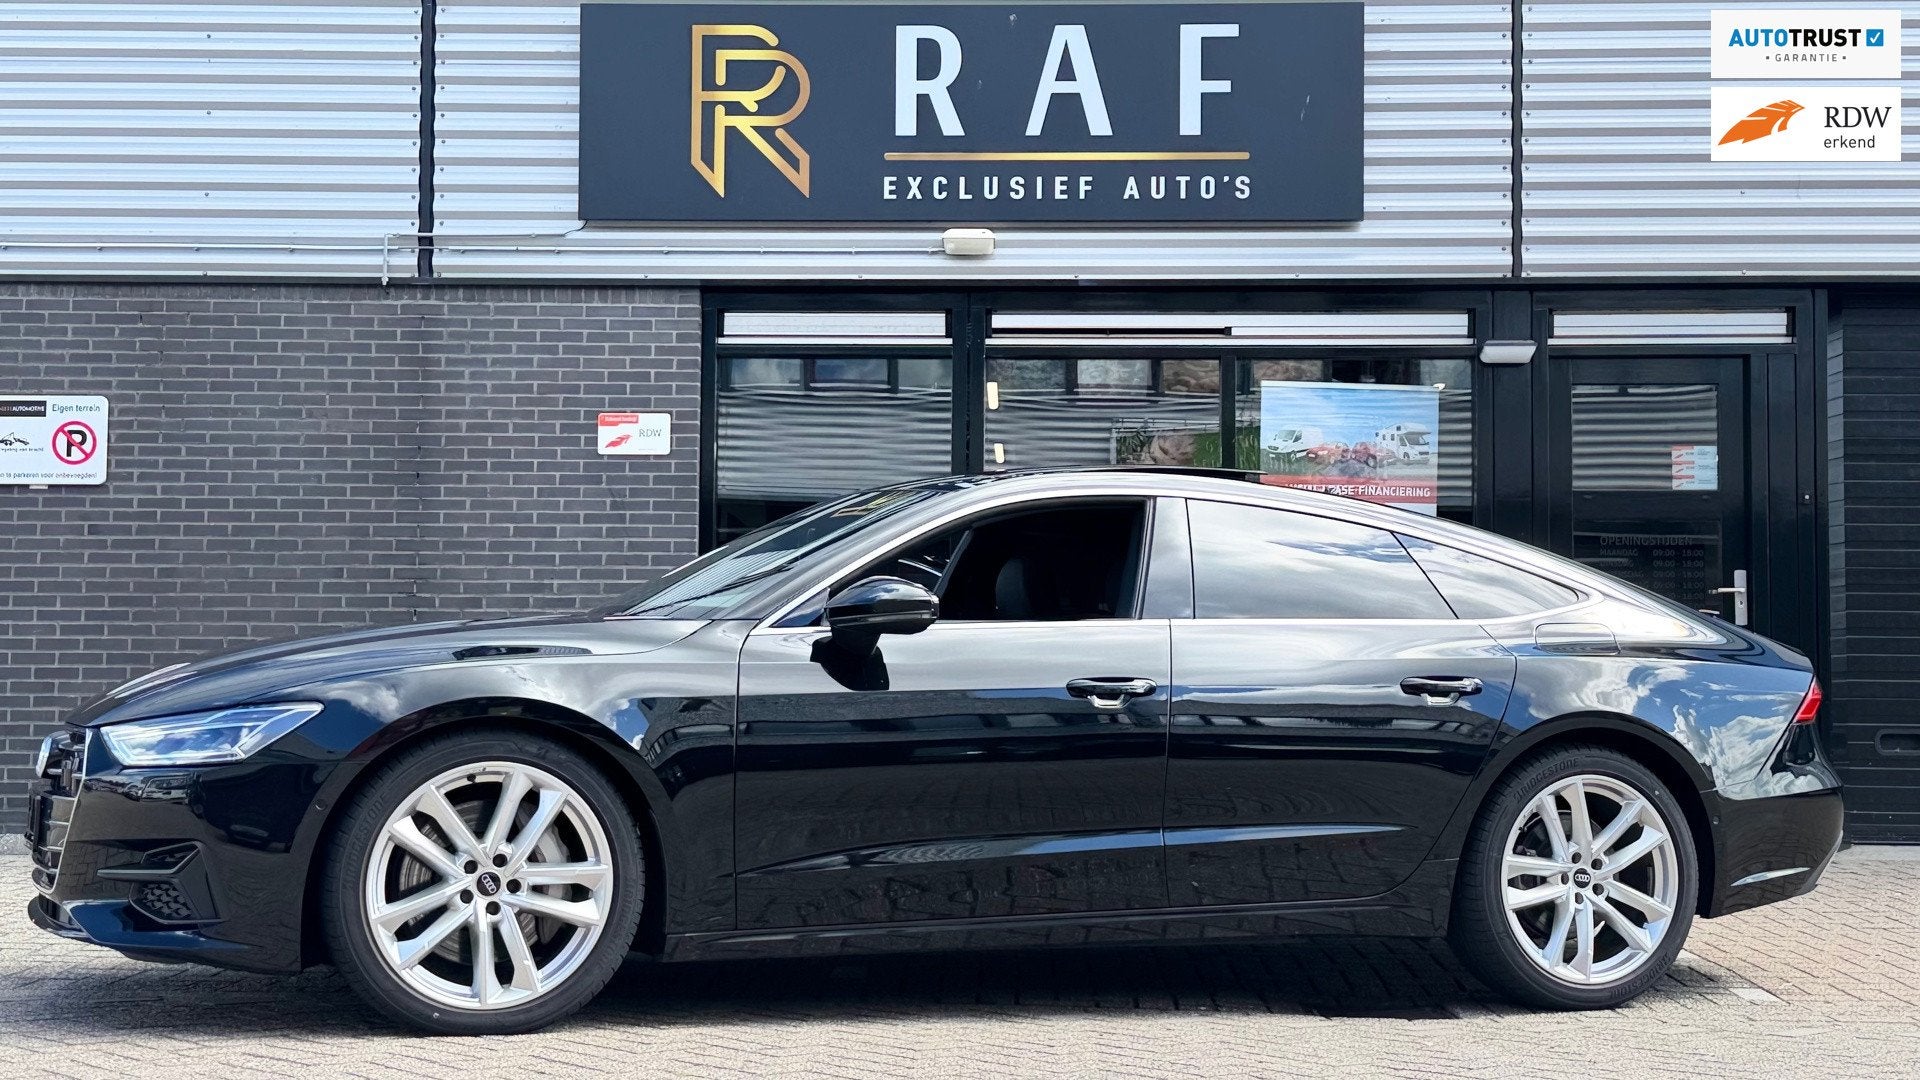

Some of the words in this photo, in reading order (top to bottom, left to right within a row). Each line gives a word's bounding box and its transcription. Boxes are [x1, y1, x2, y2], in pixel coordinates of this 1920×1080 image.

[895, 24, 1240, 137] RAF
[883, 176, 1093, 200] EXCLUSIEF
[1123, 176, 1251, 200] AUTO'S
[52, 403, 74, 413] Eigen
[638, 428, 662, 438] RDW
[1358, 485, 1431, 498] FINANCIERING
[1600, 536, 1692, 546] OPENINGSTIJDEN
[1511, 757, 1580, 803] BRIDGESTONE
